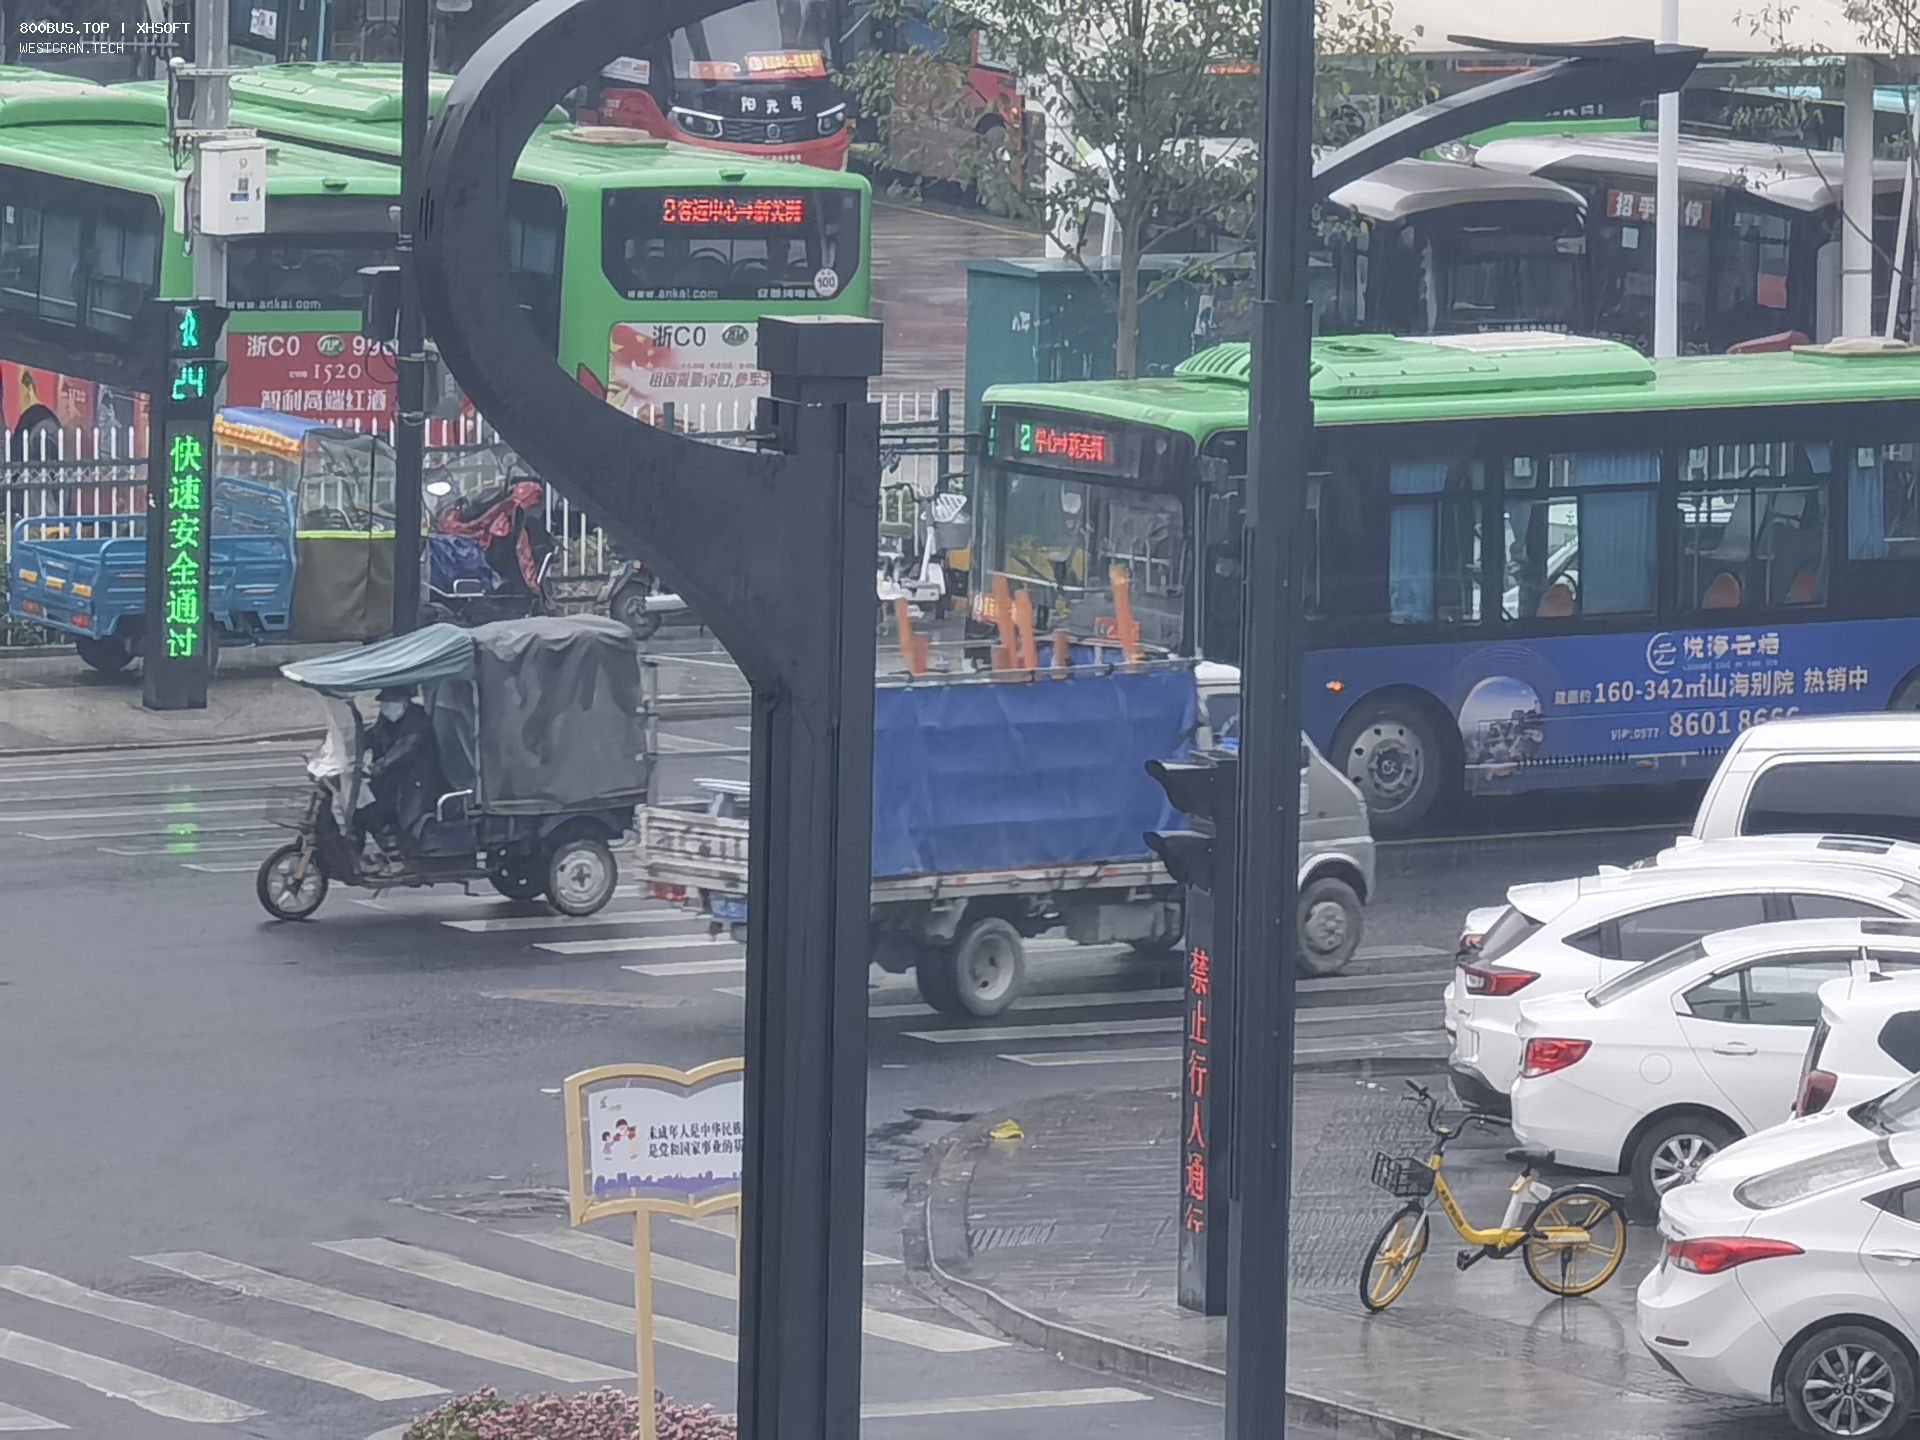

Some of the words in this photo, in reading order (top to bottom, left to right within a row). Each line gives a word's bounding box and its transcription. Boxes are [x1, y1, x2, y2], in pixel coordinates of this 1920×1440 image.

[1615, 191, 1703, 227] 招手停
[246, 334, 301, 357] 浙C0
[652, 325, 707, 349] 浙C0
[171, 366, 204, 401] 24
[313, 363, 362, 385] 1520
[260, 388, 387, 412] 智利高端红酒
[1020, 424, 1031, 452] 2
[1803, 665, 1869, 694] 热销中
[1669, 709, 1731, 737] 8601
[1185, 947, 1210, 1234] 禁止行人通行
